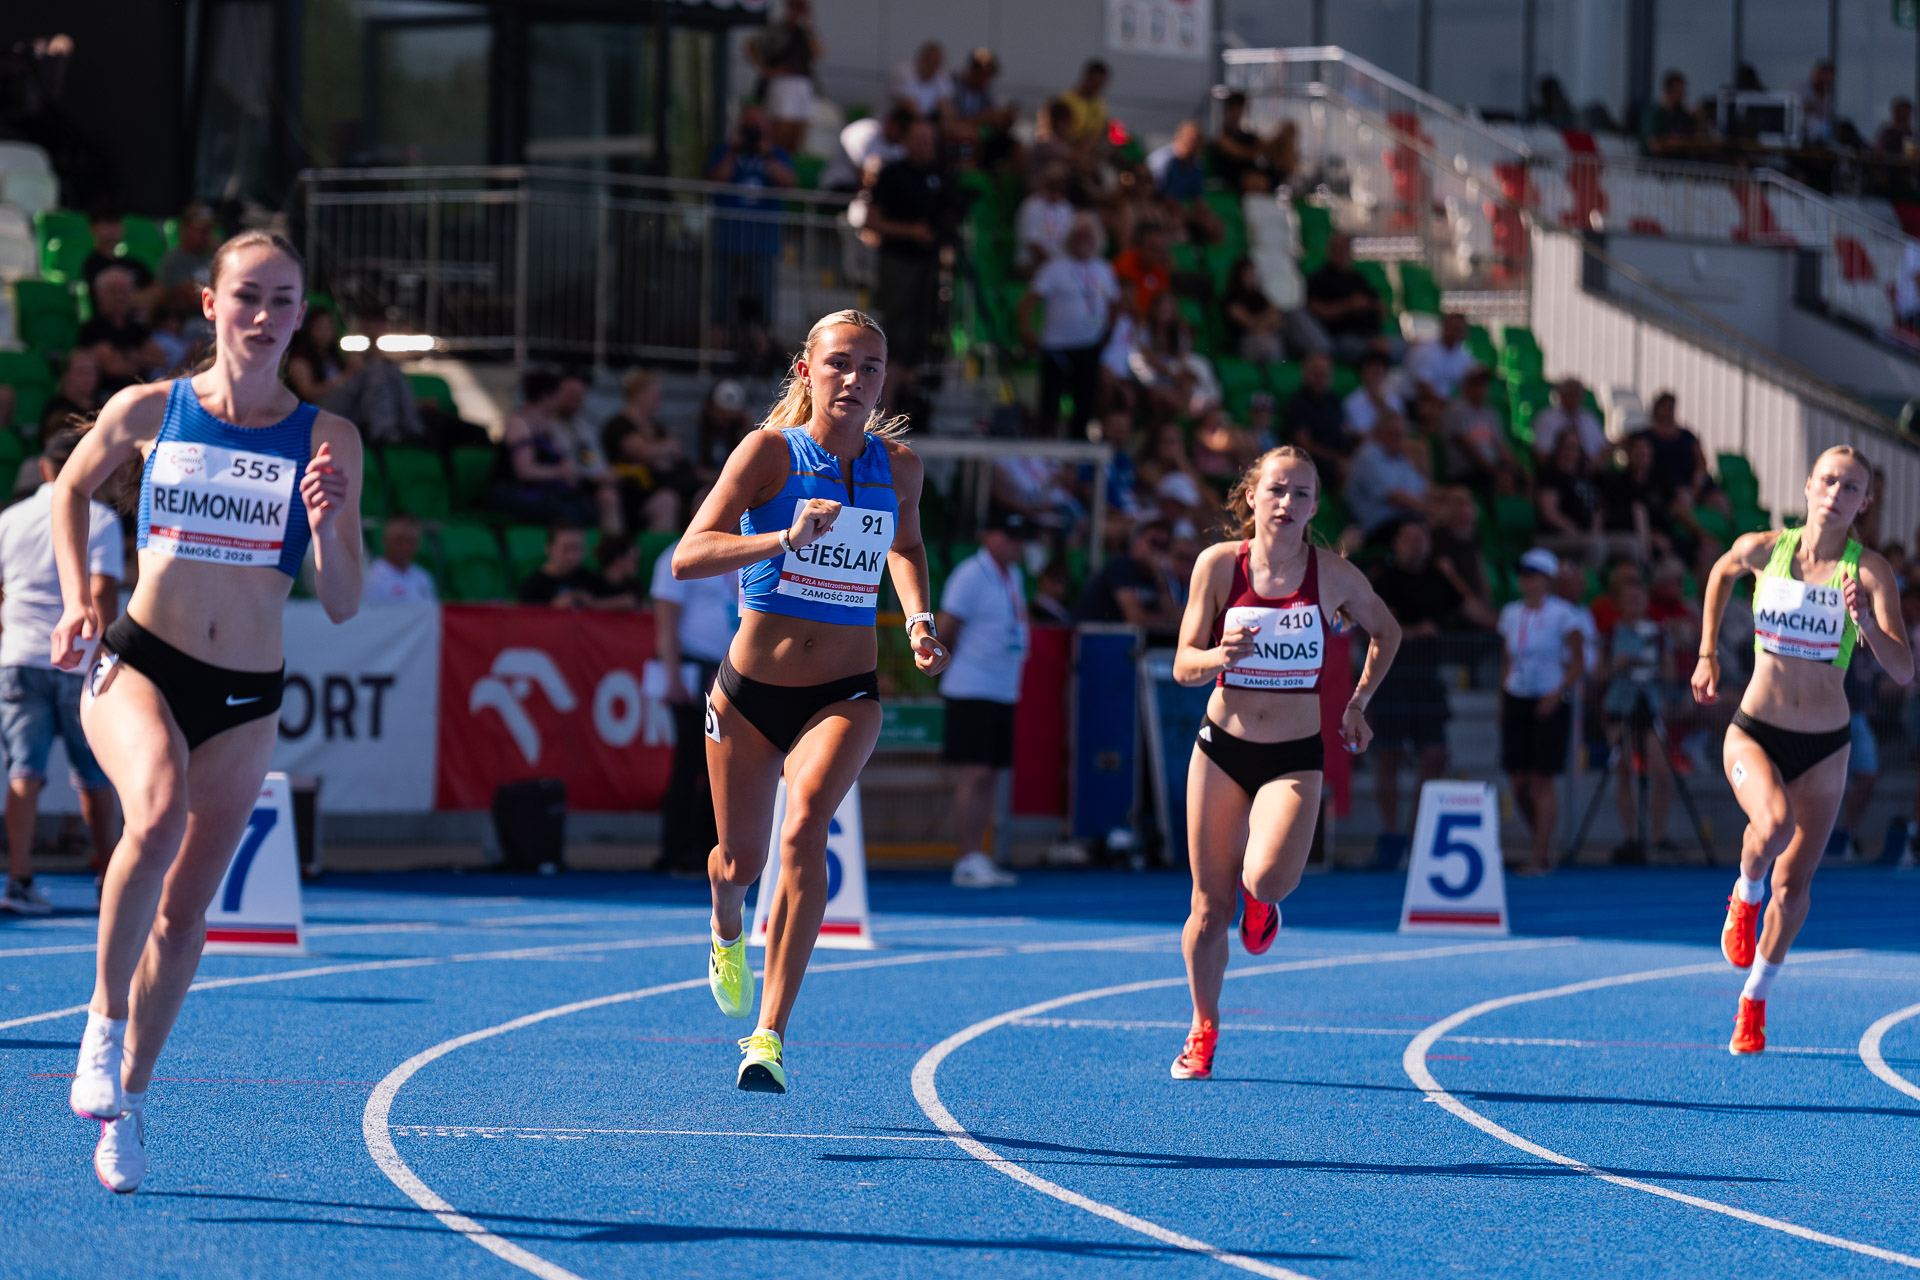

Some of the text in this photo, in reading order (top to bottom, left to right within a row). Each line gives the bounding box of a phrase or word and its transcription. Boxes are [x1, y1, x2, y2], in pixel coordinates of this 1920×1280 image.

[231, 457, 280, 483] 555
[153, 486, 283, 527] REJMONIAK
[861, 514, 883, 535] 91
[795, 543, 882, 572] CIEŚLAK
[790, 574, 801, 583] 80.
[801, 577, 816, 585] PZLA
[817, 580, 851, 590] Mistrzostwa
[851, 584, 866, 592] Polski
[801, 588, 864, 604] ZAMOŚĆ 2026
[1806, 588, 1838, 607] 413
[1279, 611, 1313, 629] 410
[1760, 608, 1837, 636] MACHAJ
[1252, 641, 1318, 660] ANDAS
[1243, 677, 1304, 686] ZAMOŚĆ 2026
[277, 672, 395, 741] ORT
[222, 808, 278, 912] 7
[1429, 812, 1485, 900] 5
